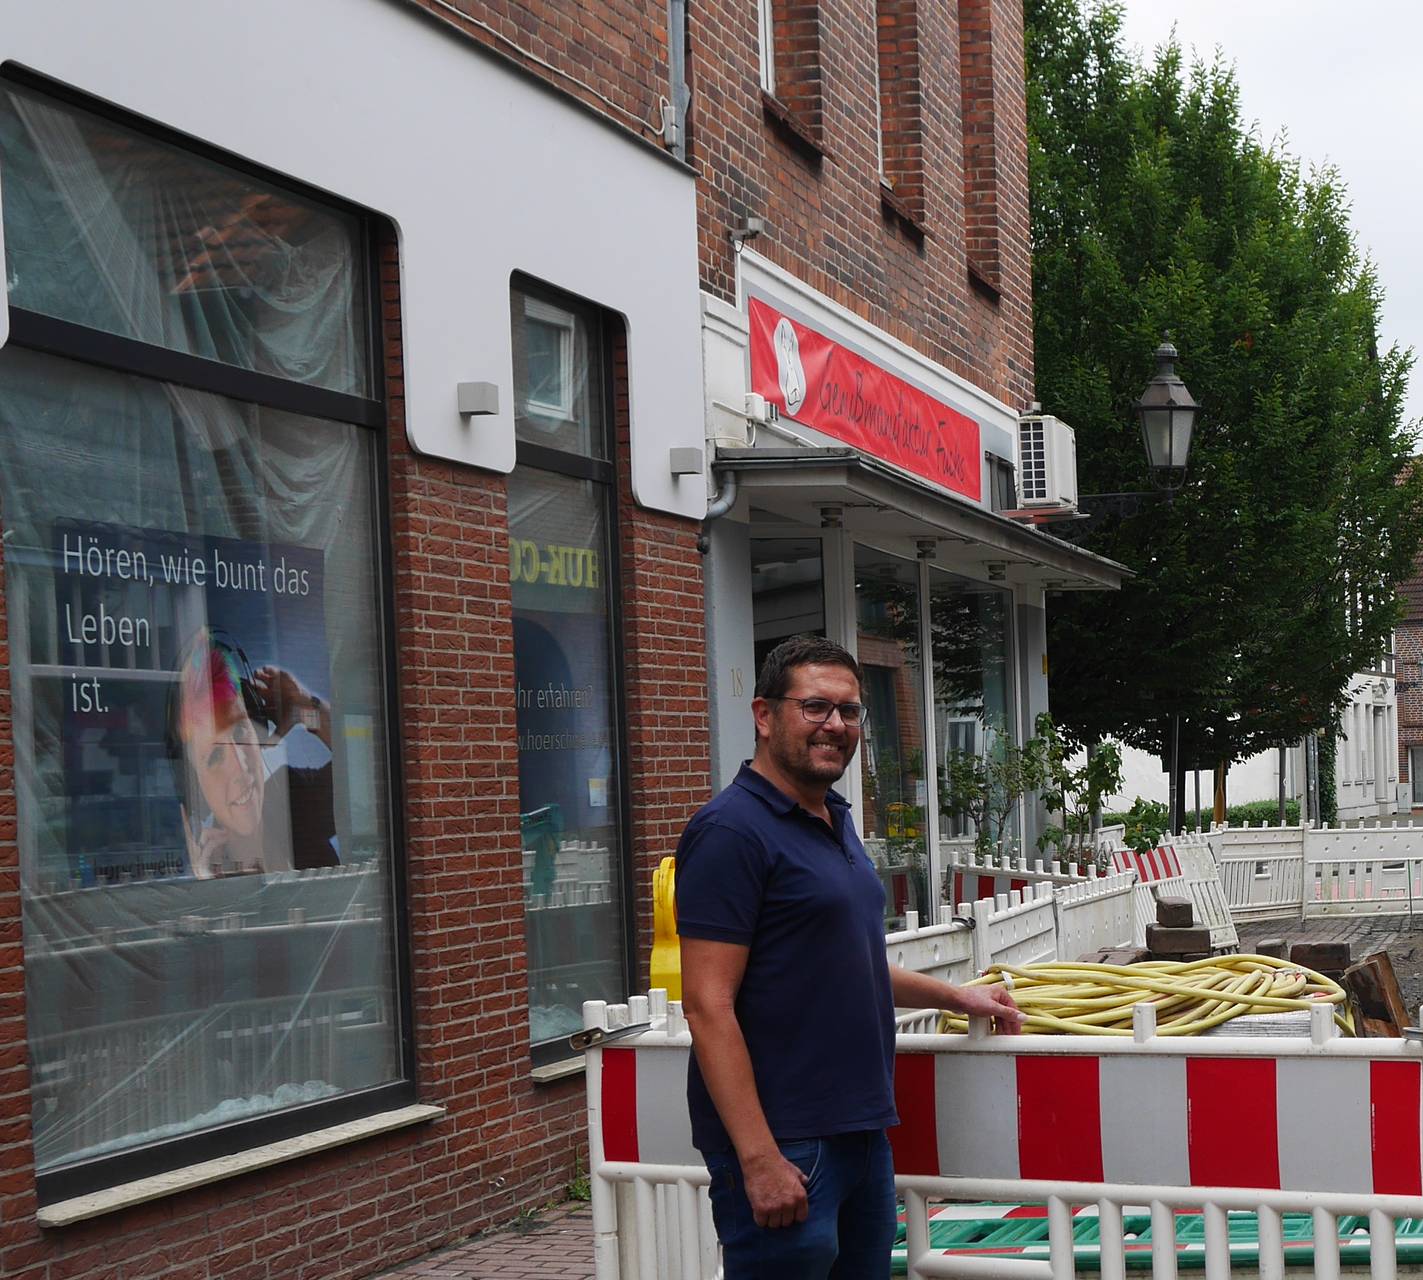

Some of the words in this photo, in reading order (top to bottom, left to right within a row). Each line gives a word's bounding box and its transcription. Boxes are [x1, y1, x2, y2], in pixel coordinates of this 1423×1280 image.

[63, 534, 153, 587] Hören,
[160, 548, 206, 586] wie
[214, 548, 267, 593] bunt
[273, 556, 310, 596] das
[65, 603, 149, 647] Leben
[72, 672, 109, 713] ist.
